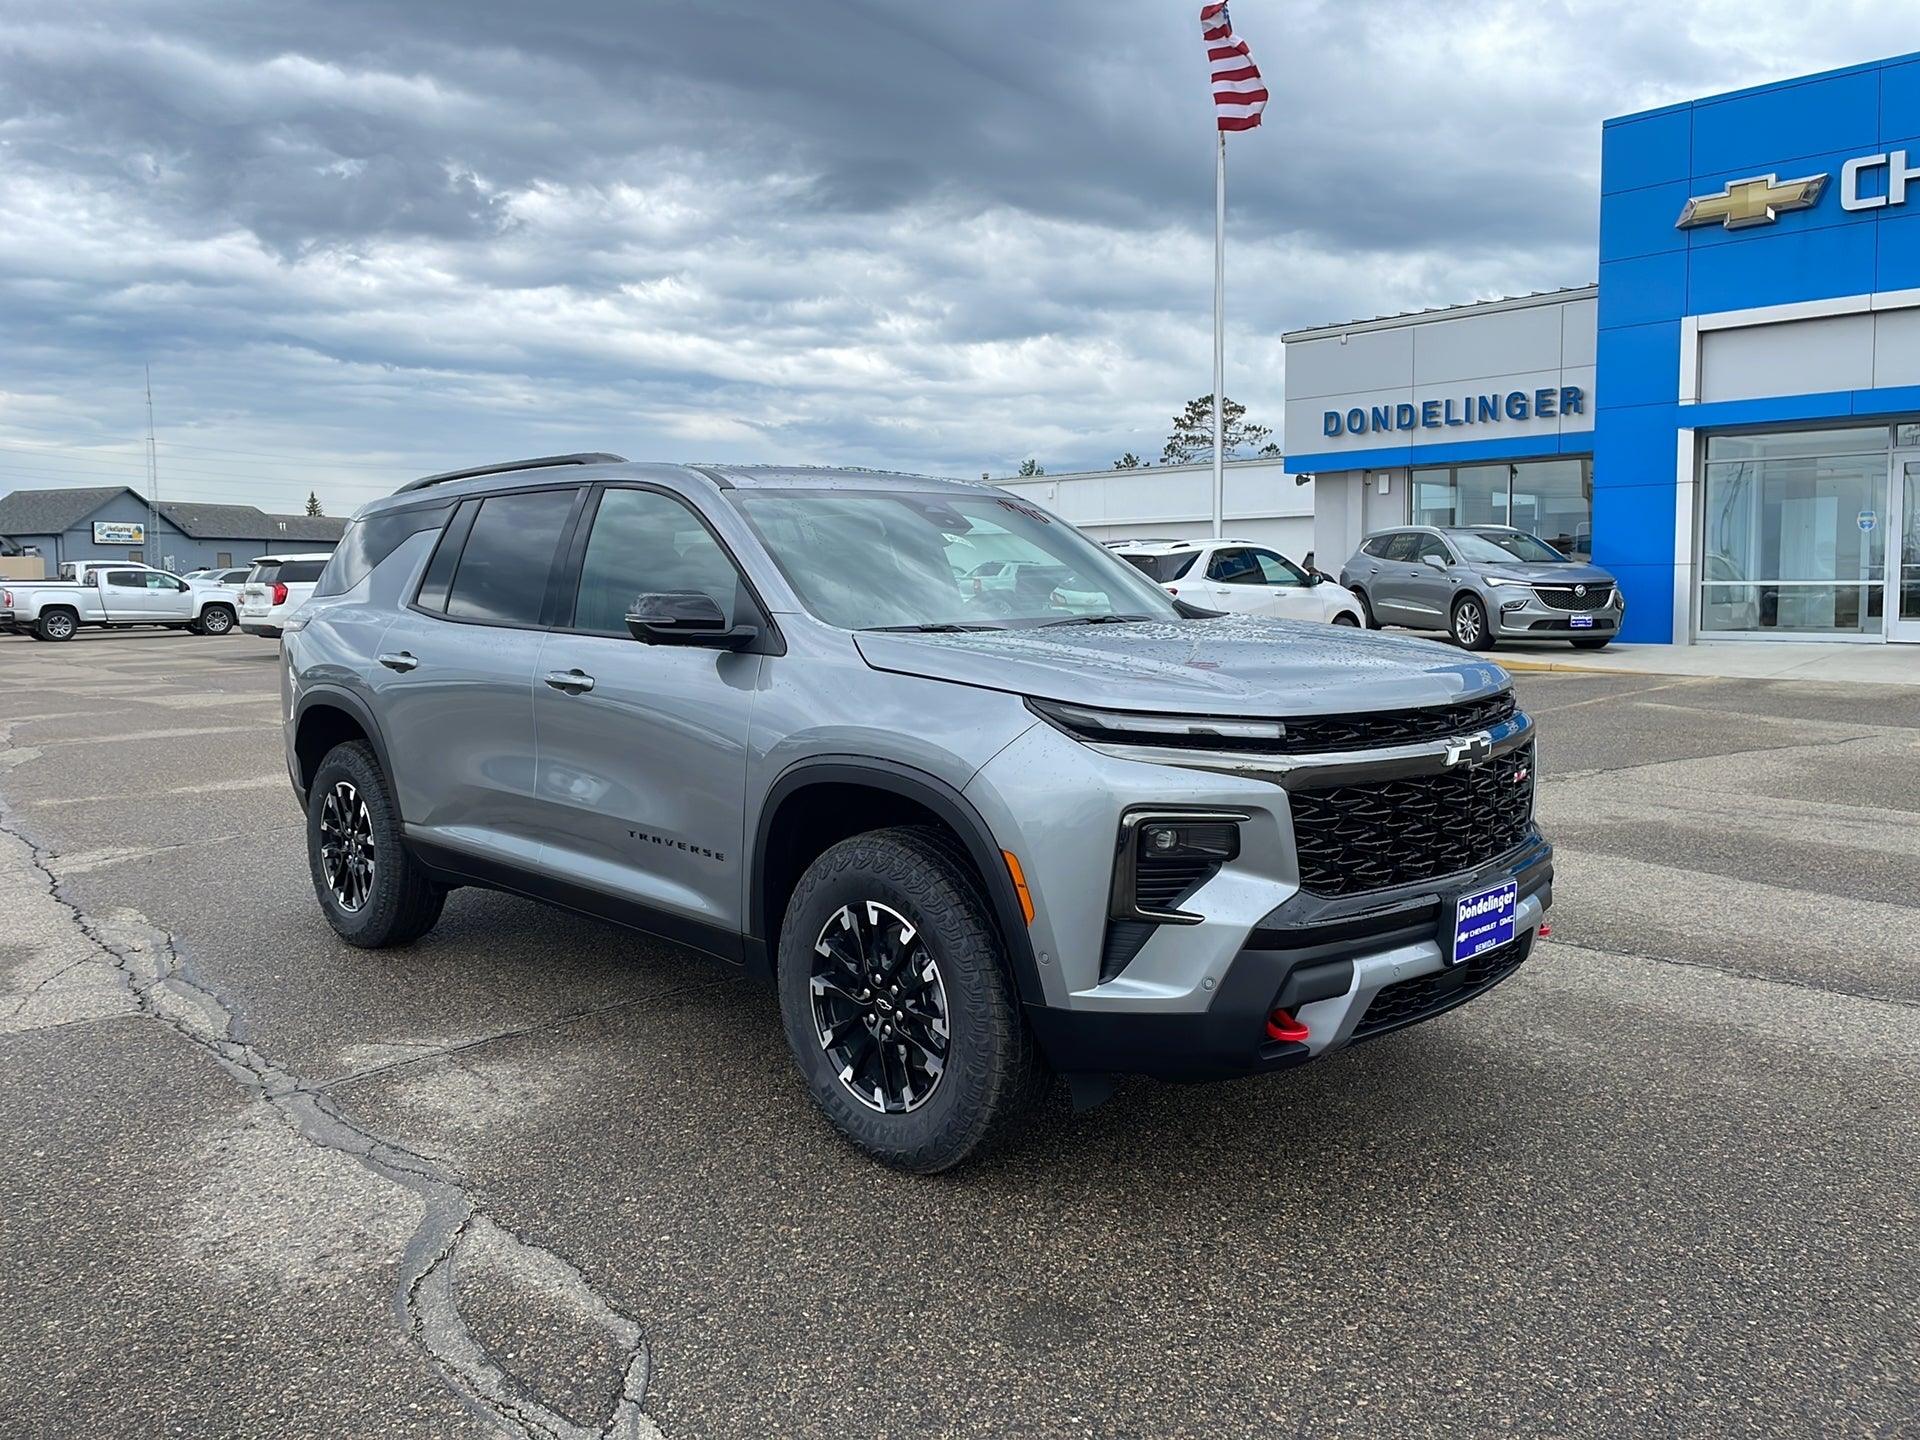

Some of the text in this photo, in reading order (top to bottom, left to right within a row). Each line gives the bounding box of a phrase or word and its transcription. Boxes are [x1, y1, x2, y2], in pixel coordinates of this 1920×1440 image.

[1323, 385, 1584, 437] DONDELINGER
[627, 829, 725, 862] TRAVERSE
[1459, 892, 1514, 922] Dondelinger
[1469, 914, 1514, 937] CHEVROLET GMC
